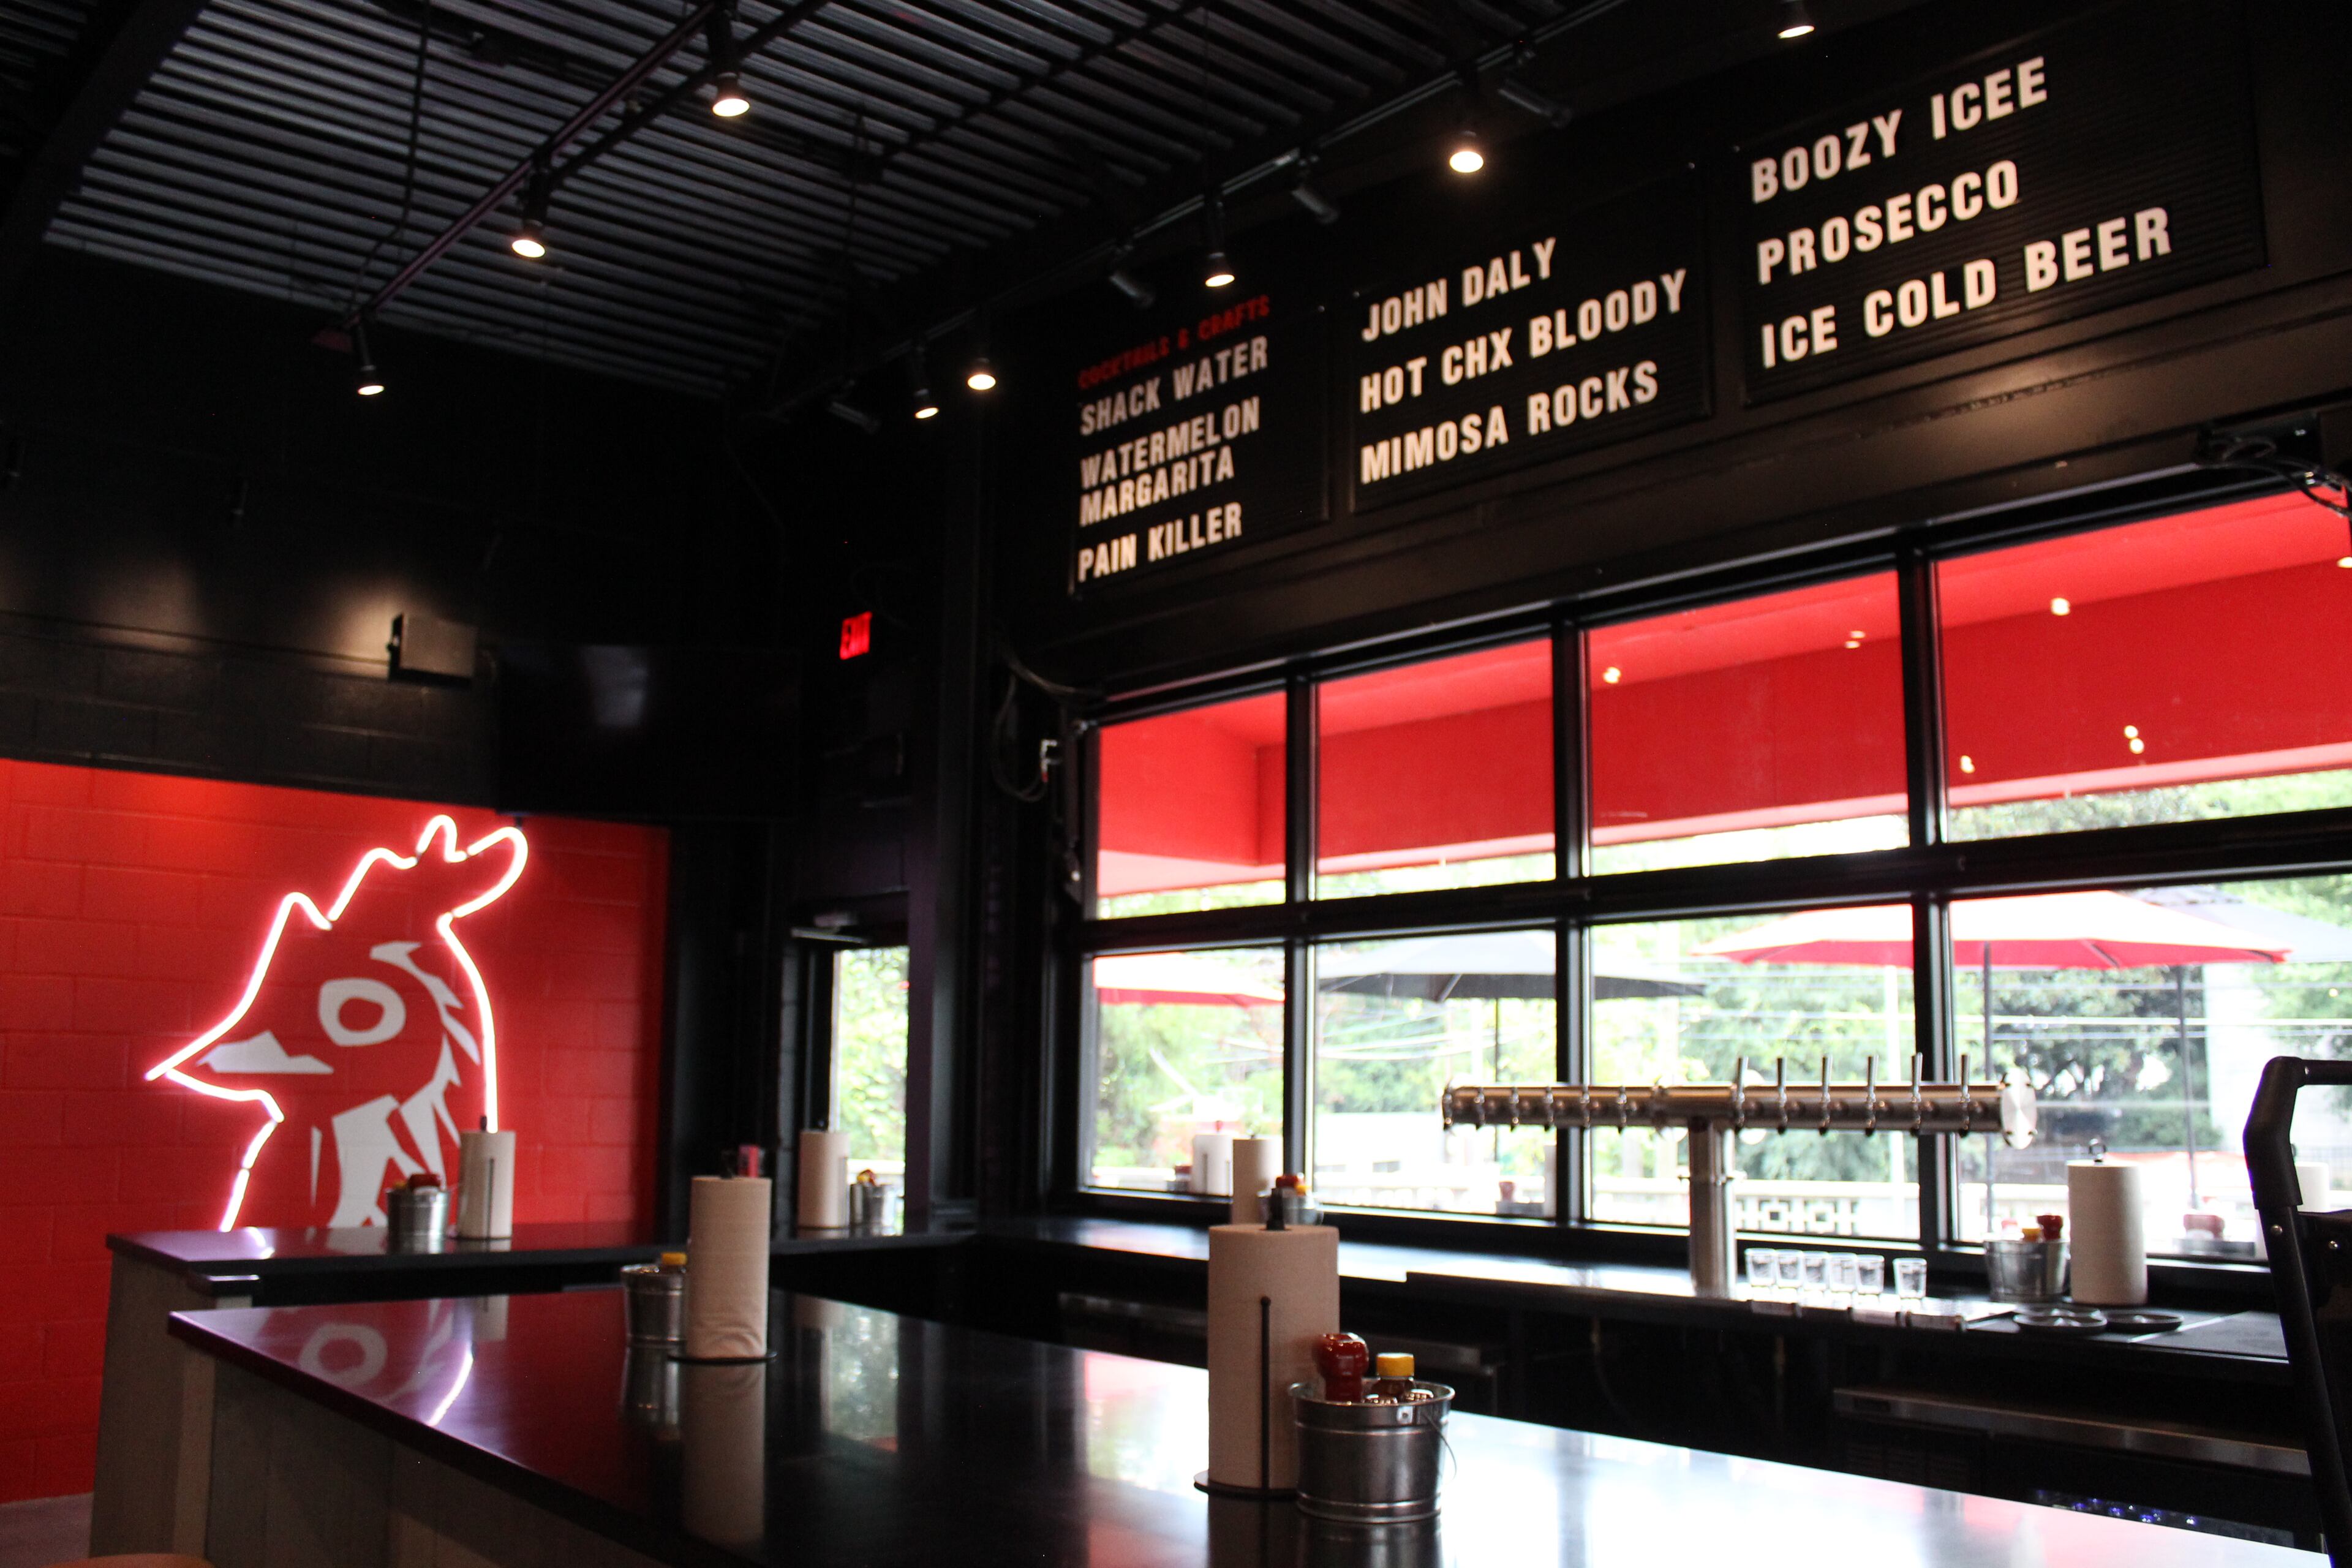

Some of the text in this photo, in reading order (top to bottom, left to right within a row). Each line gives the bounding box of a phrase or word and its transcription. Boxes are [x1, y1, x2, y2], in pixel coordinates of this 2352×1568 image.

[1752, 56, 2048, 204] BOOZY ICEE
[1757, 159, 2019, 285] PROSECCO
[1198, 294, 1270, 341] CRAFTS
[1361, 236, 1556, 342] JOHN DALY
[1761, 206, 2172, 369] ICE COLD BEER
[1081, 336, 1268, 436] SHACK WATER
[1360, 268, 1687, 414] HOT CHX BLOODY
[1081, 396, 1260, 490] WATERMELON
[1360, 360, 1659, 485] MIMOSA ROCKS
[1080, 446, 1234, 527] MARGARITA
[1077, 502, 1242, 582] PAIN KILLER
